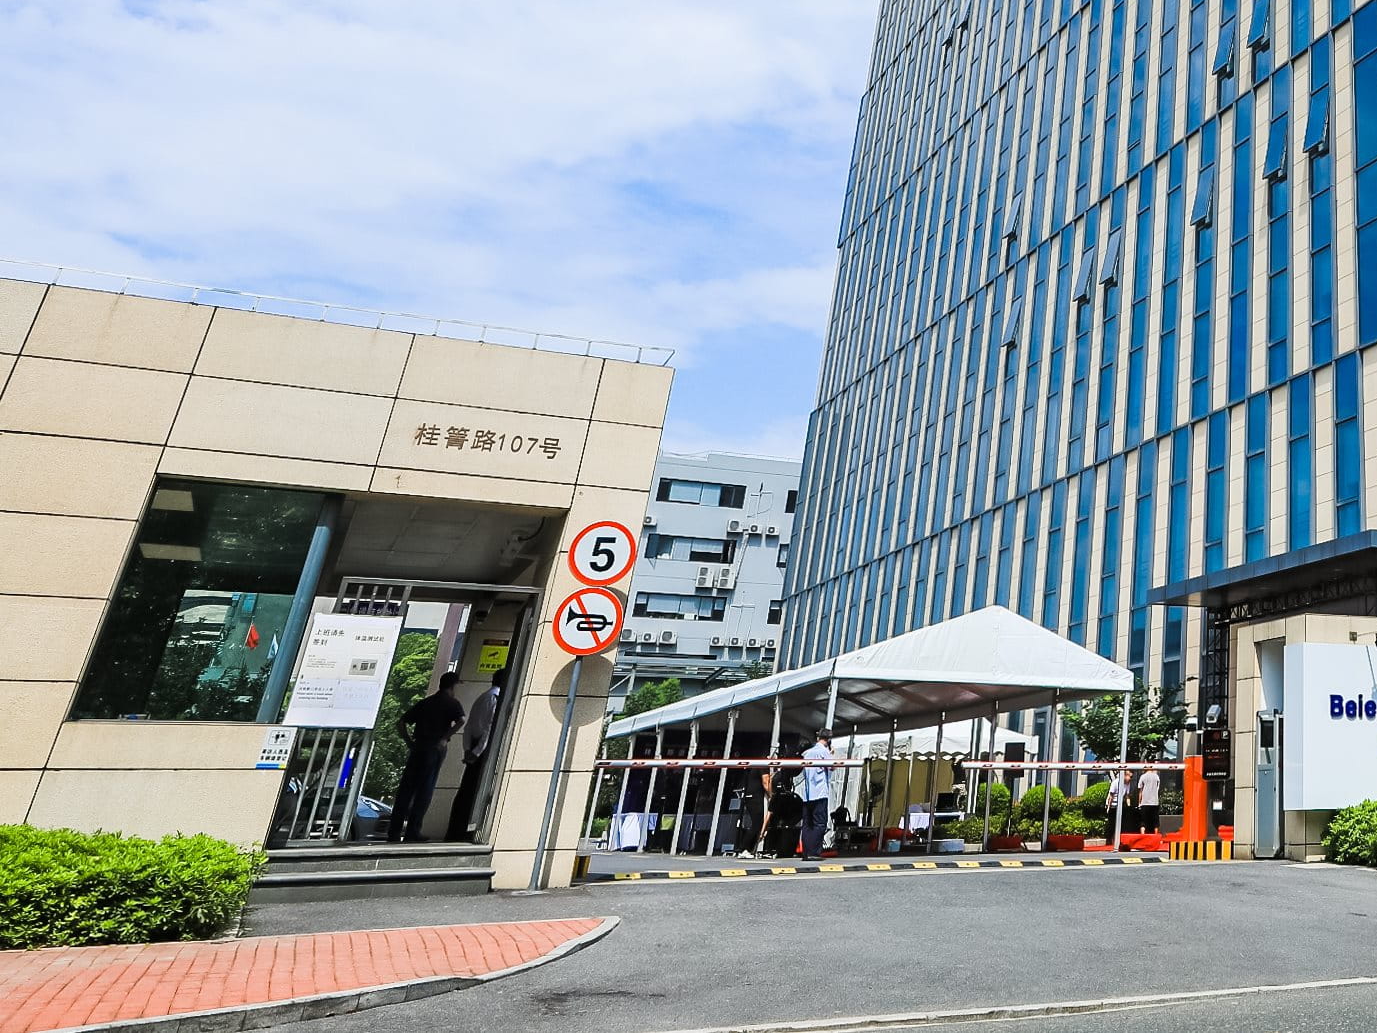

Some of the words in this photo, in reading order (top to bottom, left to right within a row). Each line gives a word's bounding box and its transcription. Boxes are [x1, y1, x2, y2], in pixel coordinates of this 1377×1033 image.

[414, 422, 562, 460] 桂箐路107号
[589, 536, 616, 573] 5
